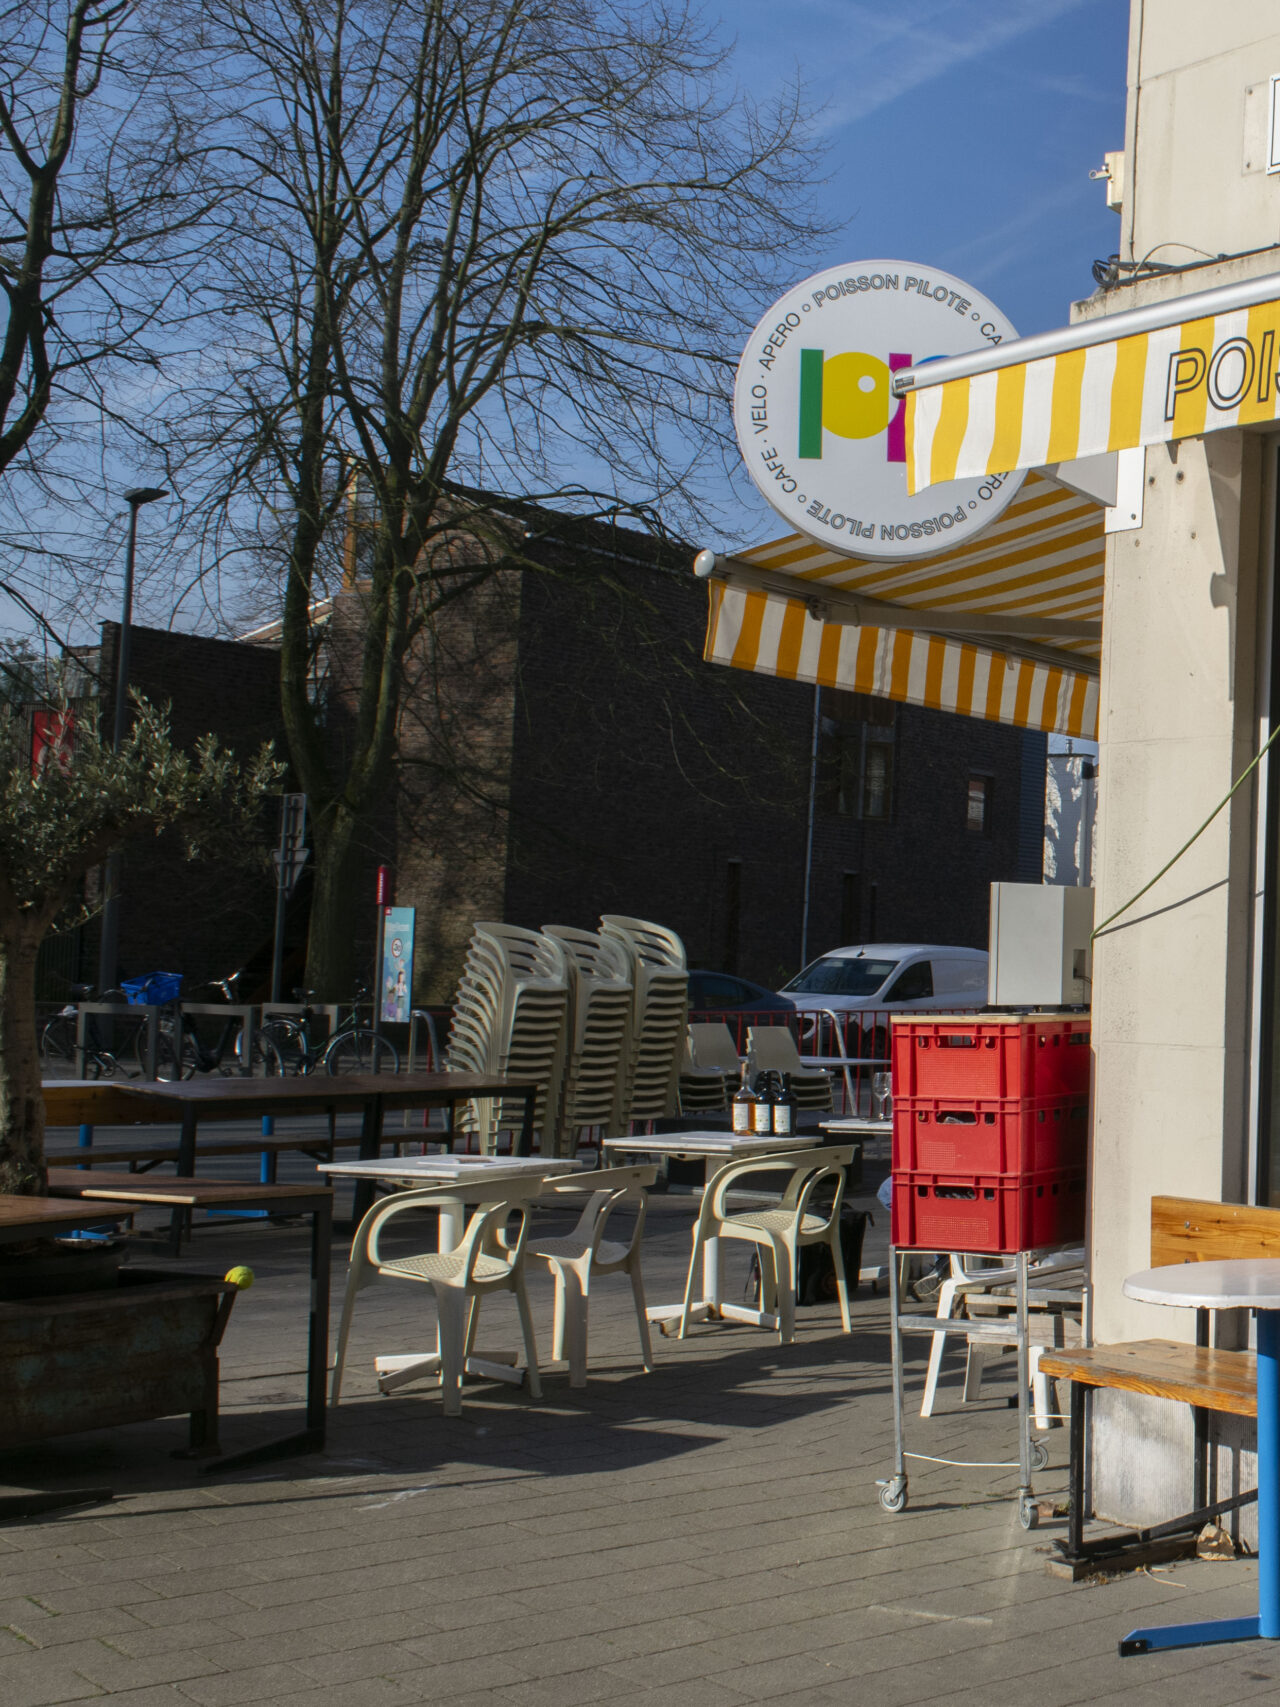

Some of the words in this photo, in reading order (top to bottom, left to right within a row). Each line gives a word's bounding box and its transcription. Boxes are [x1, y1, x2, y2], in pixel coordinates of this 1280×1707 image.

[811, 273, 899, 308] POISSON
[904, 276, 972, 316] PILOTE
[758, 312, 801, 371] APERO
[751, 384, 769, 435] VELO
[761, 447, 797, 493] CAFE
[806, 500, 876, 539] PILOTE
[880, 505, 968, 541] POISSON
